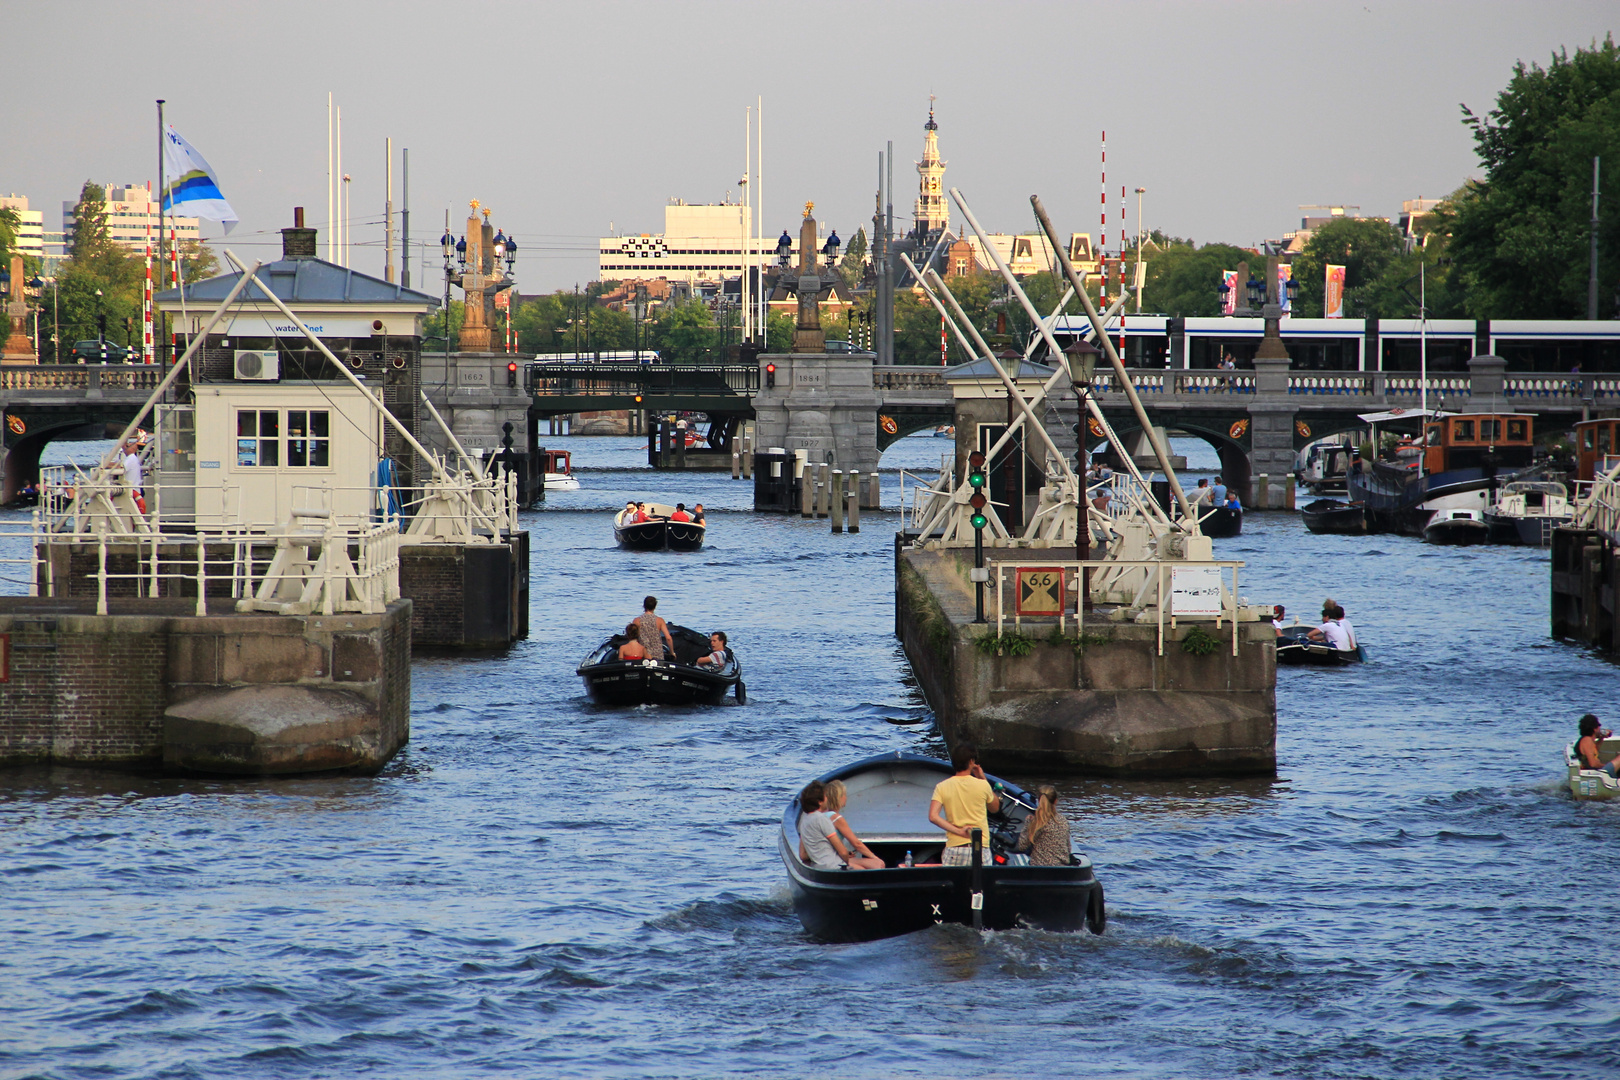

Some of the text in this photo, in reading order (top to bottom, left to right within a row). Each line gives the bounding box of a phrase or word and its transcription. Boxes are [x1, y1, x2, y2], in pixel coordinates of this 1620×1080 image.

[464, 373, 483, 381] 1662
[463, 438, 482, 446] 2012
[1029, 573, 1051, 588] 6,6
